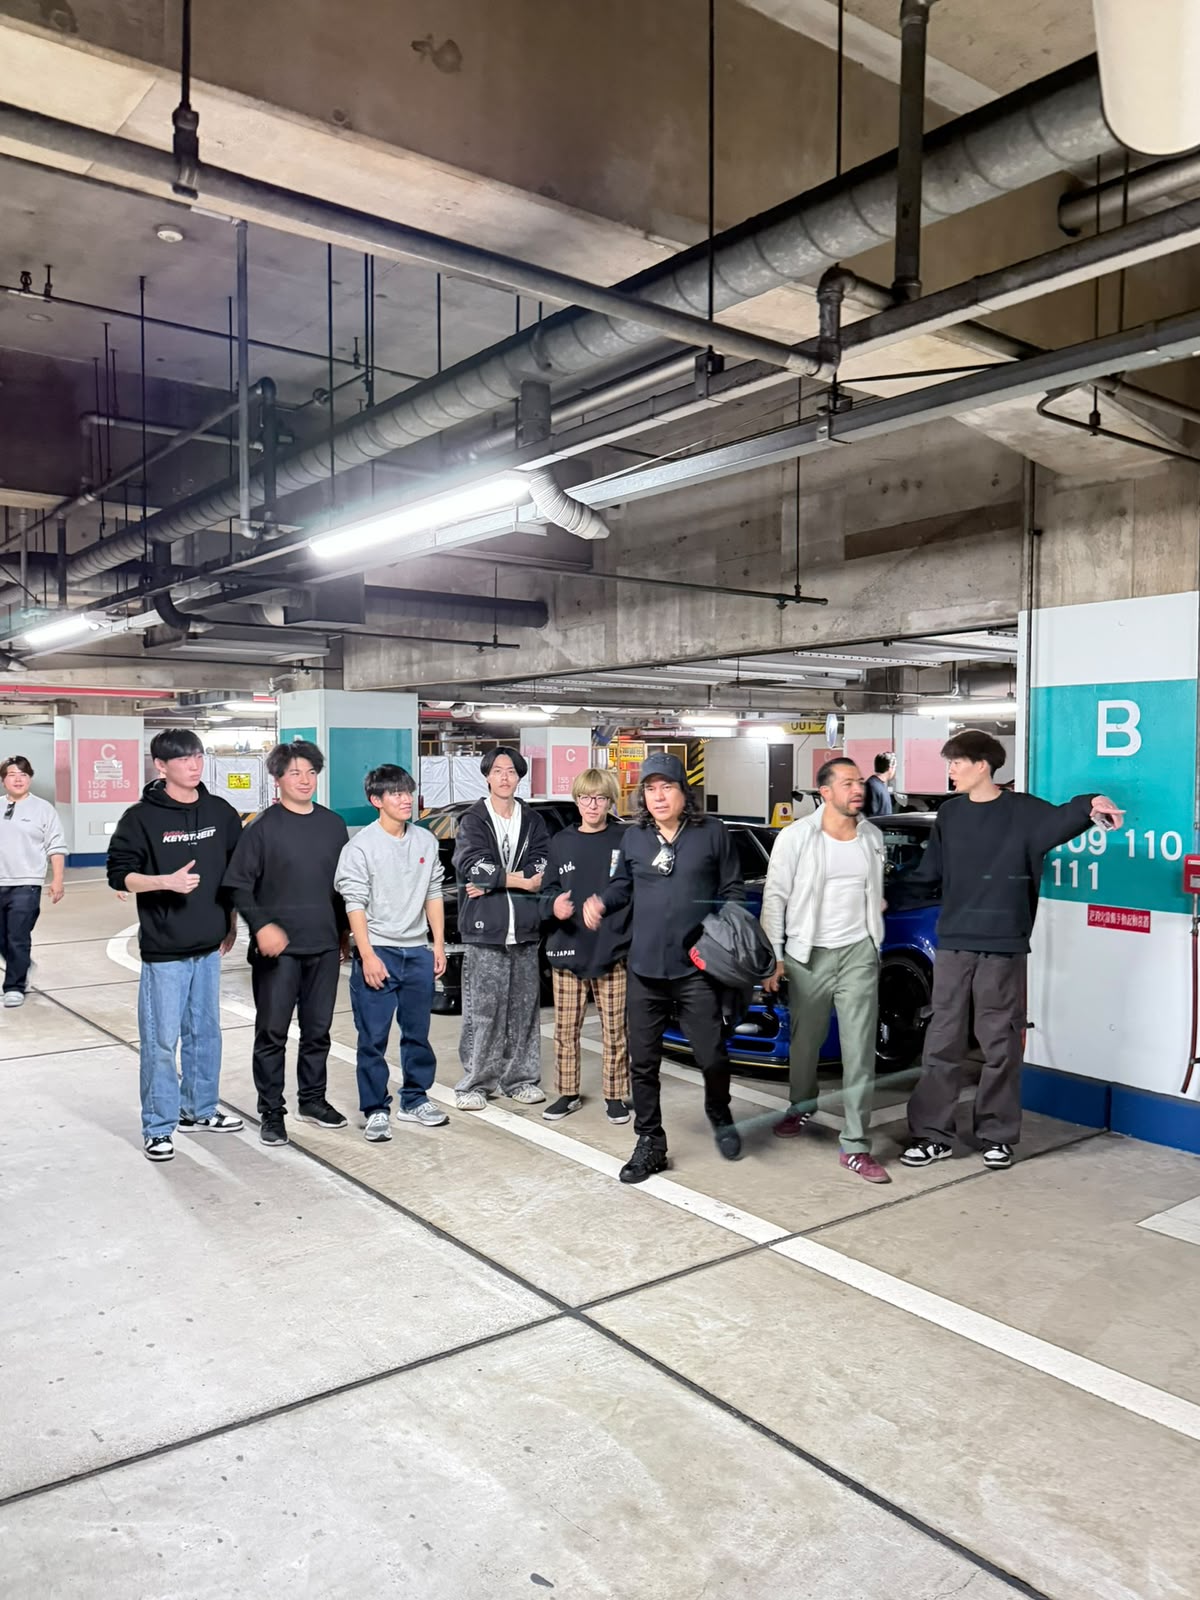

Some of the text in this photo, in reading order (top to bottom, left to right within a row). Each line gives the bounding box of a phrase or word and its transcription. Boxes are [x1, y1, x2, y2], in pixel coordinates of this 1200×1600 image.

[1097, 699, 1142, 757] B
[101, 743, 117, 760] C
[566, 748, 576, 762] C
[87, 780, 107, 789] 152
[87, 790, 107, 799] 154
[1055, 827, 1182, 861] 09 110
[1051, 858, 1099, 890] 111
